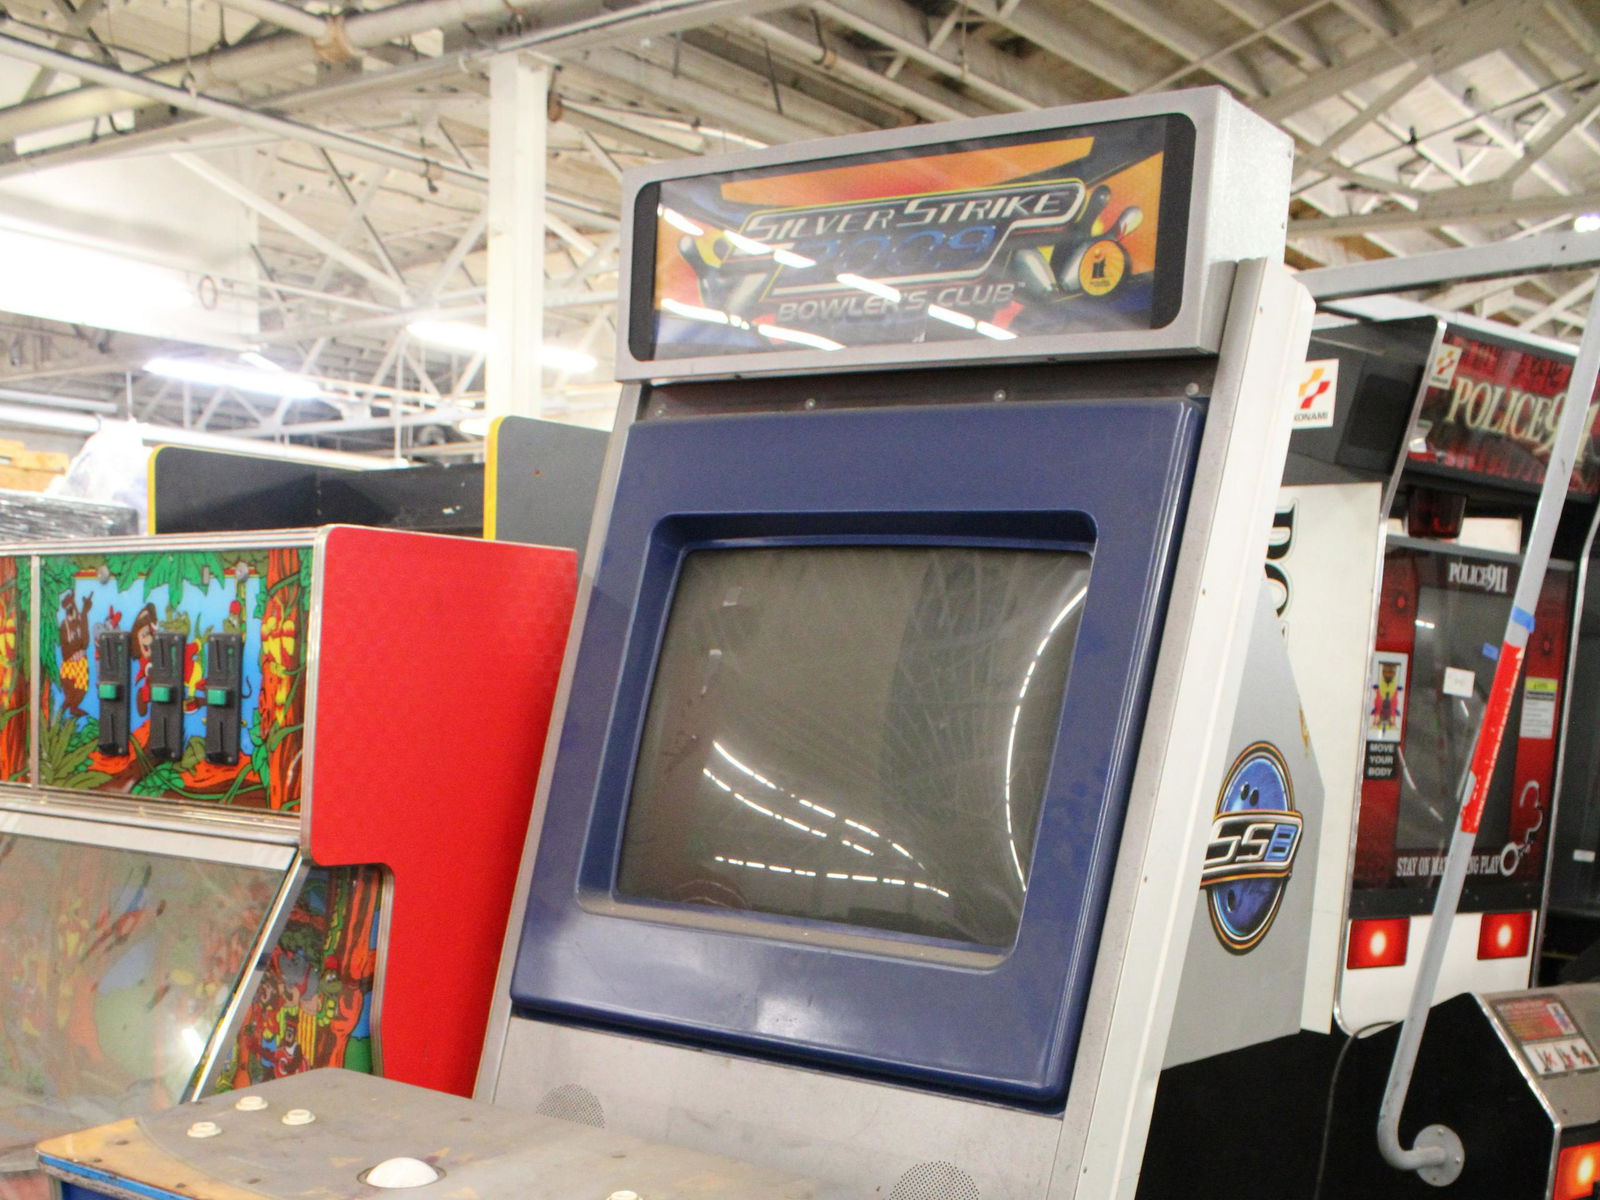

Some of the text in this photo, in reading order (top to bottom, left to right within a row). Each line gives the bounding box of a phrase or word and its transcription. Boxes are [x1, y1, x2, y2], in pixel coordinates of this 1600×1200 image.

[746, 191, 1069, 242] SILVER STRIKE
[937, 284, 1015, 308] CLUB
[1369, 743, 1395, 753] MOVE
[1369, 755, 1394, 765] YOUR
[1367, 767, 1393, 777] BODY
